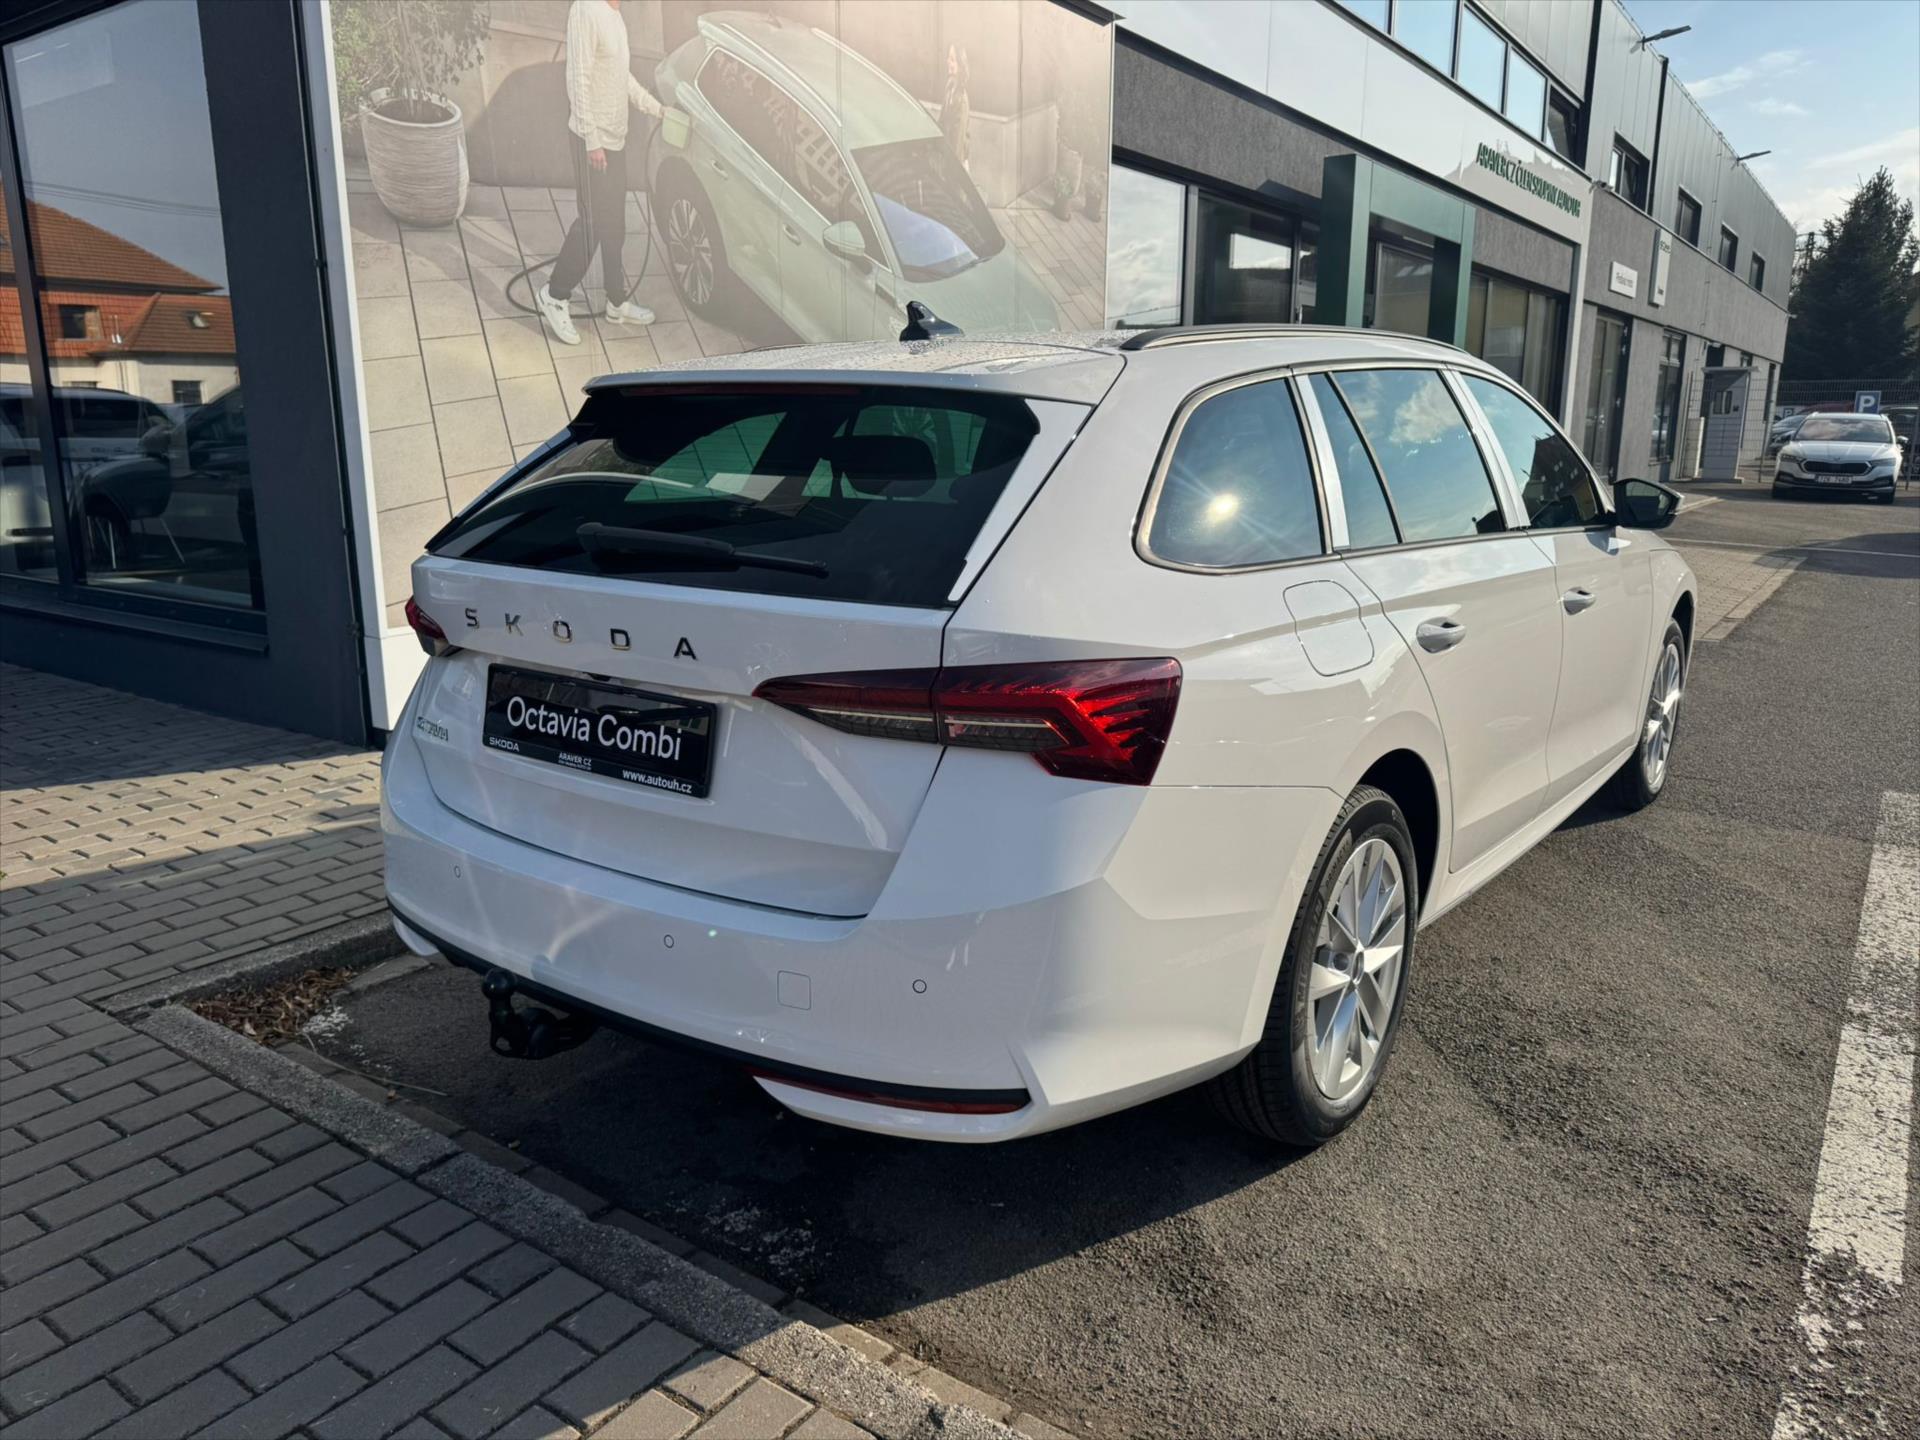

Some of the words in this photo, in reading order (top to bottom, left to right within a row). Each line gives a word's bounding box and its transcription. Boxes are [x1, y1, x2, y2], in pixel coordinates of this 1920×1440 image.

[1859, 395, 1875, 413] P
[507, 696, 591, 742] Octavia
[597, 714, 683, 761] Combi
[558, 751, 583, 765] ARAVER
[582, 757, 593, 768] CZ
[622, 769, 693, 794] www.autouh.cz
